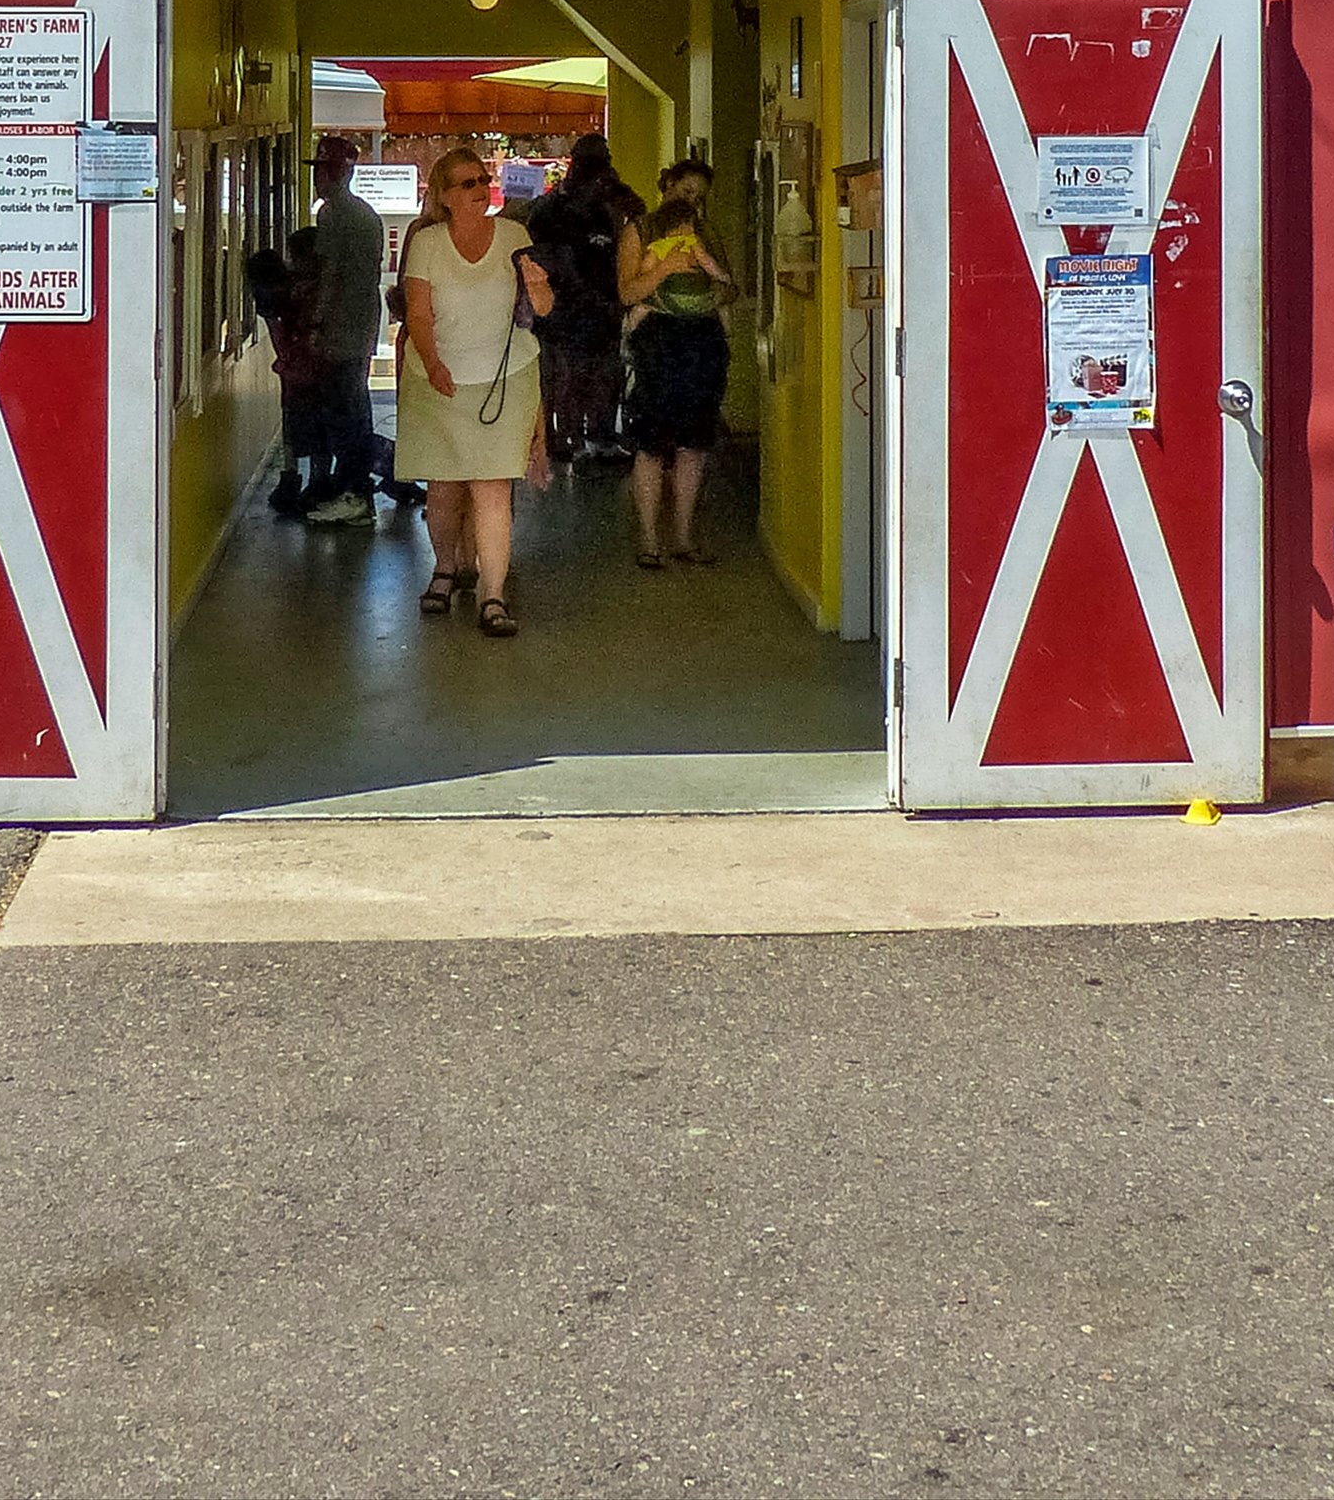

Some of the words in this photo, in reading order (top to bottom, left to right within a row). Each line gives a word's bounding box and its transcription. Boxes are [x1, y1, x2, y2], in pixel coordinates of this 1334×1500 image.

[44, 19, 79, 33] FARM
[17, 54, 59, 65] experience
[62, 54, 79, 63] here
[64, 70, 77, 78] any
[18, 81, 32, 89] the
[35, 81, 68, 89] animals.
[20, 94, 38, 102] loan
[27, 125, 53, 134] LABOR
[58, 126, 76, 134] DAY
[20, 187, 27, 195] 2
[32, 189, 47, 197] yrs
[52, 187, 73, 195] free
[1, 203, 32, 211] outside
[36, 203, 50, 211] the
[54, 203, 73, 211] farm
[31, 243, 40, 253] by
[58, 242, 78, 251] adult
[30, 272, 78, 288] AFTER
